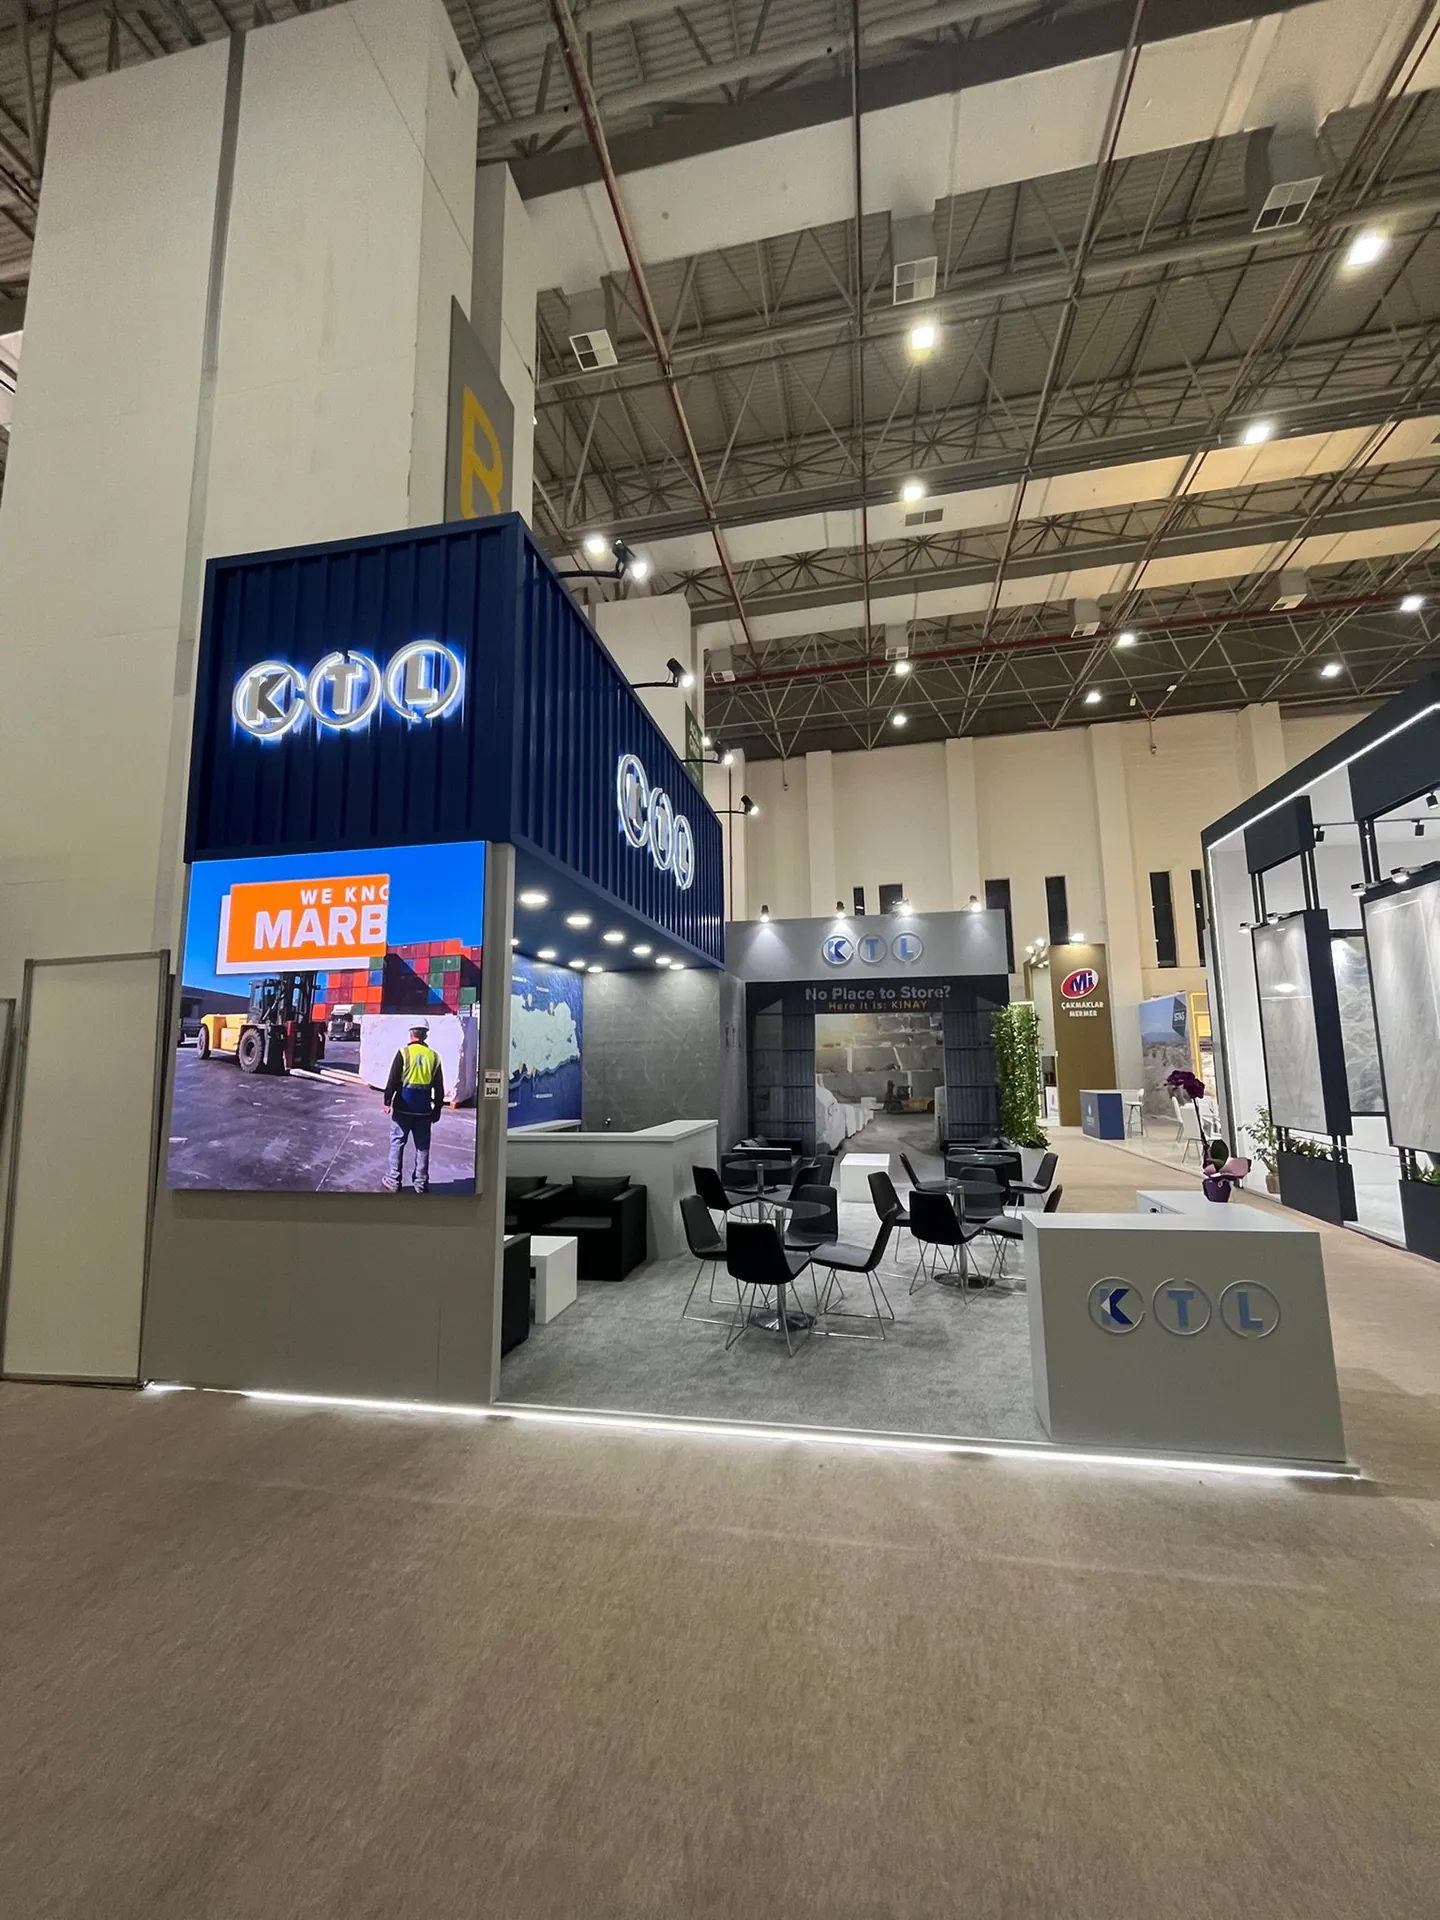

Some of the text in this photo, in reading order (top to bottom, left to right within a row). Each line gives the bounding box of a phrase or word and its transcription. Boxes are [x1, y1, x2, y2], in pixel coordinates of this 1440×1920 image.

[246, 650, 440, 726] KTL
[300, 888, 333, 905] WE
[253, 904, 388, 950] MARB
[825, 936, 916, 962] KTL
[805, 985, 951, 1000] No Place to Store?
[828, 1001, 856, 1011] Here
[891, 999, 929, 1010] KINAY
[1061, 1001, 1104, 1011] ÇAKMAKLAR
[1069, 1010, 1098, 1018] MERMER
[1098, 1286, 1264, 1331] KTL
